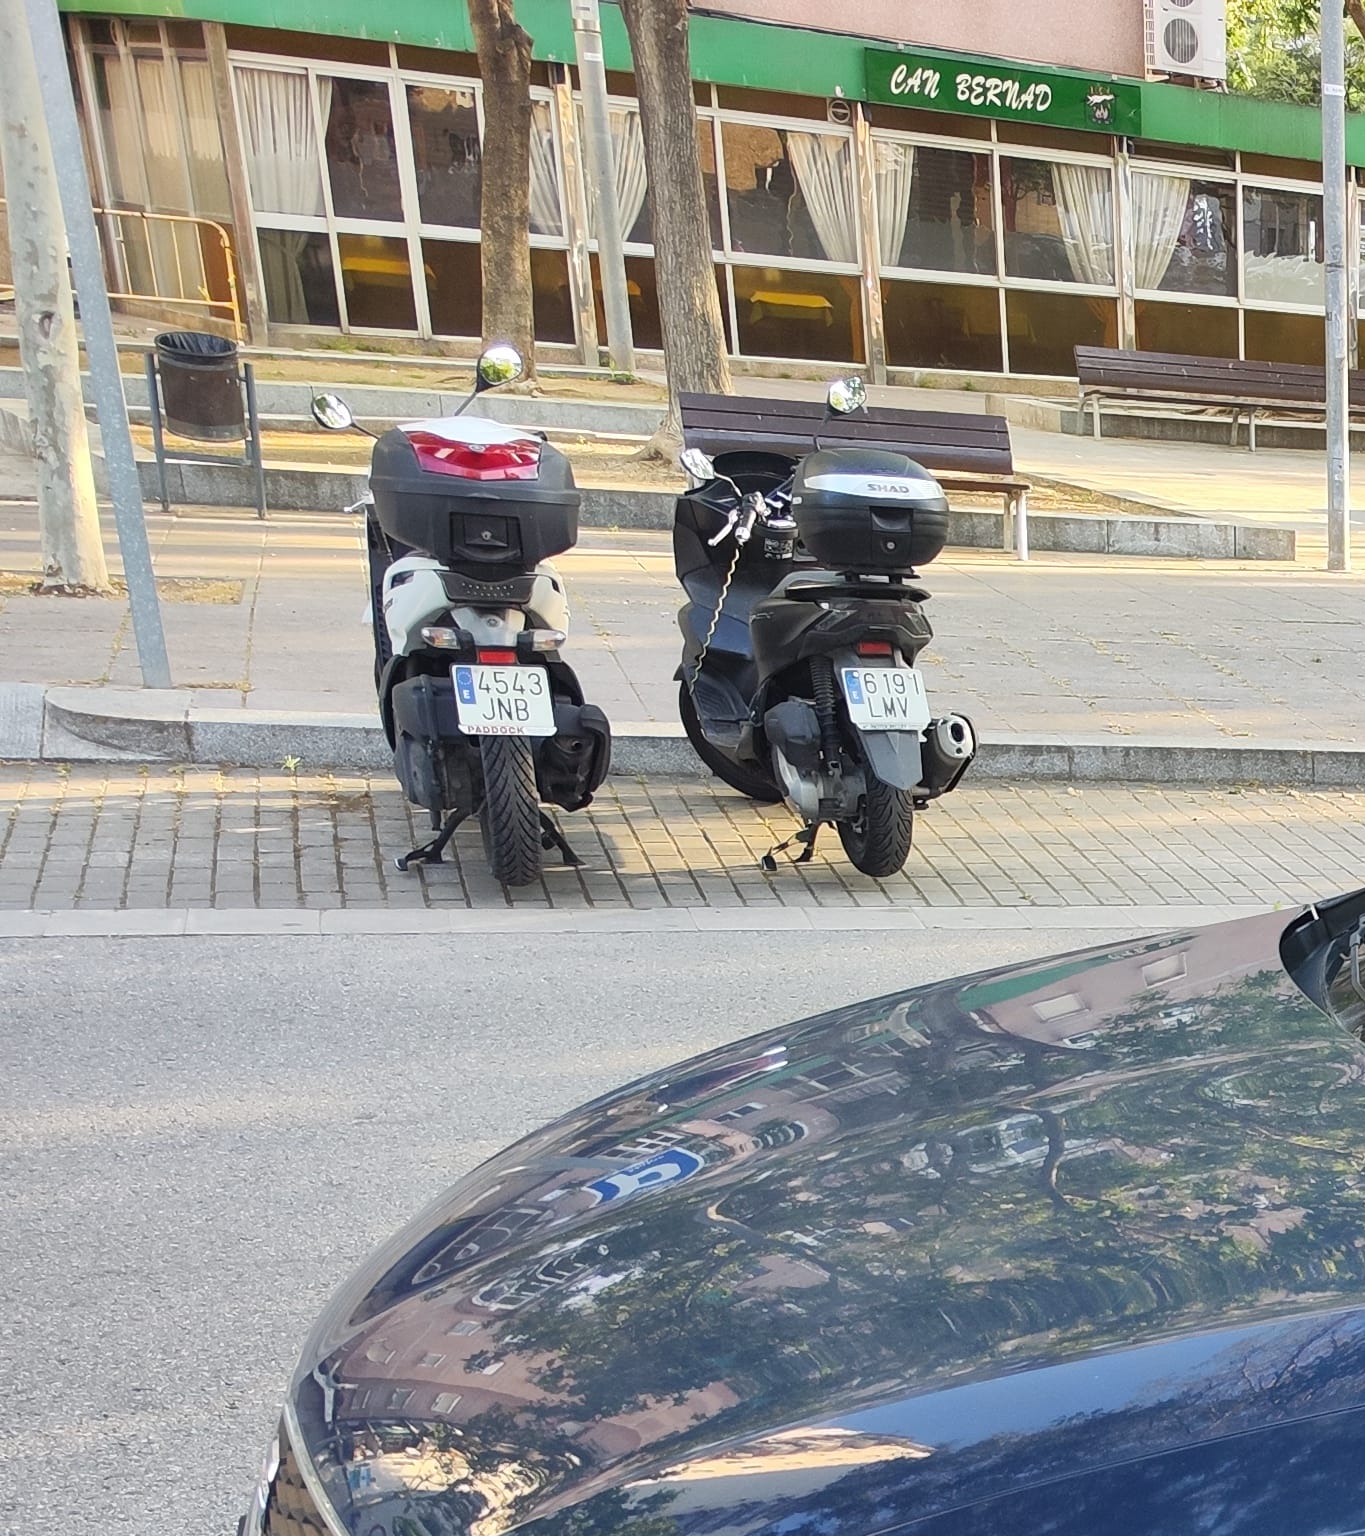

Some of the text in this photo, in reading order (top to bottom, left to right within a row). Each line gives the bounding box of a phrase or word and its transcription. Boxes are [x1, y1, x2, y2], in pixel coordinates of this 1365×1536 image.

[890, 64, 1052, 112] CAN BERNAD
[867, 483, 910, 494] SHAD
[462, 689, 470, 699] E
[478, 671, 543, 696] 4543
[863, 672, 920, 696] 6191
[482, 697, 530, 722] JNB
[867, 696, 908, 718] LMV
[467, 725, 525, 735] PADDOCK
